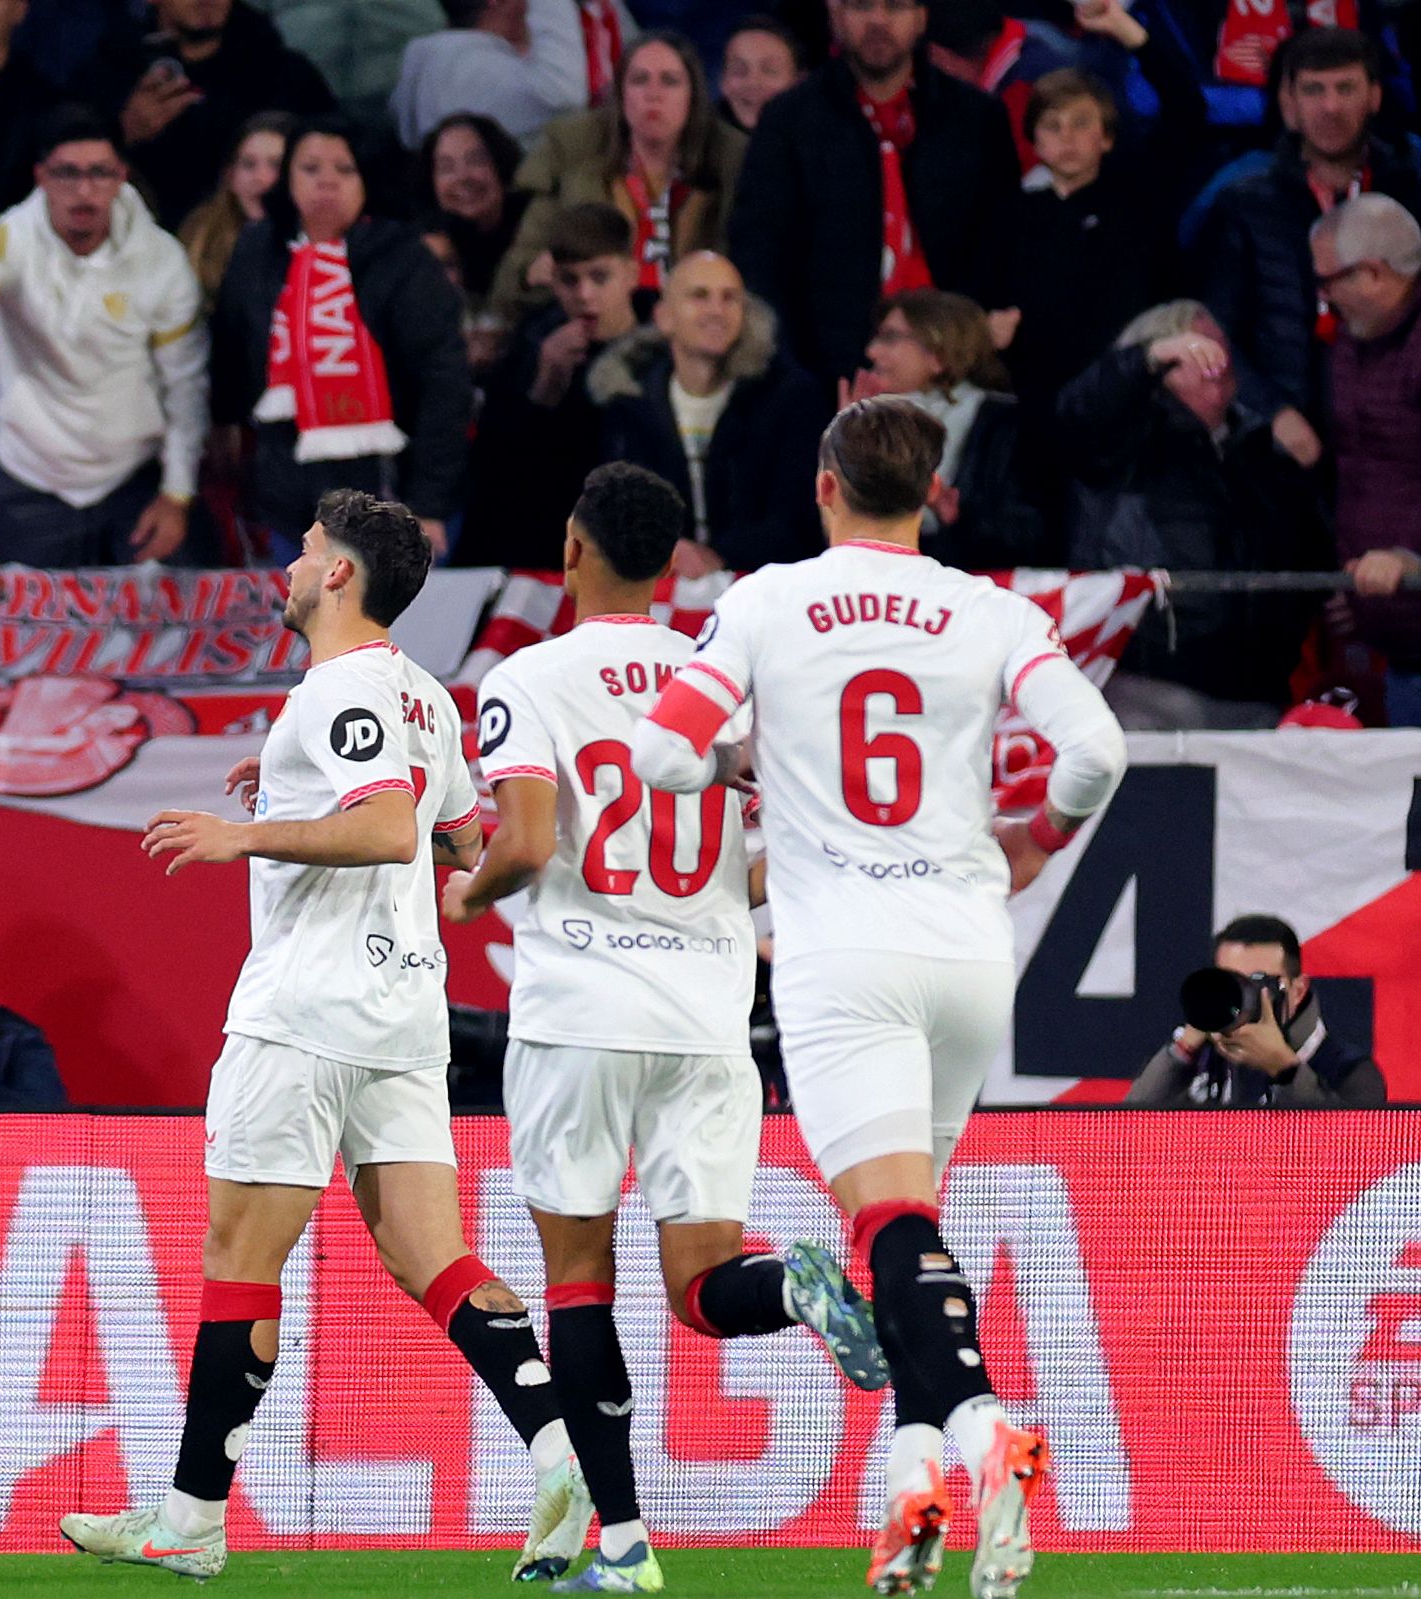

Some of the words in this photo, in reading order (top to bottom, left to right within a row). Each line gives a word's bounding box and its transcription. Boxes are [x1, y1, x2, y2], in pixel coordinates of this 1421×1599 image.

[806, 593, 953, 635] GUDELJ
[340, 718, 378, 756] JD
[839, 668, 924, 828] 6
[575, 738, 726, 898] 20
